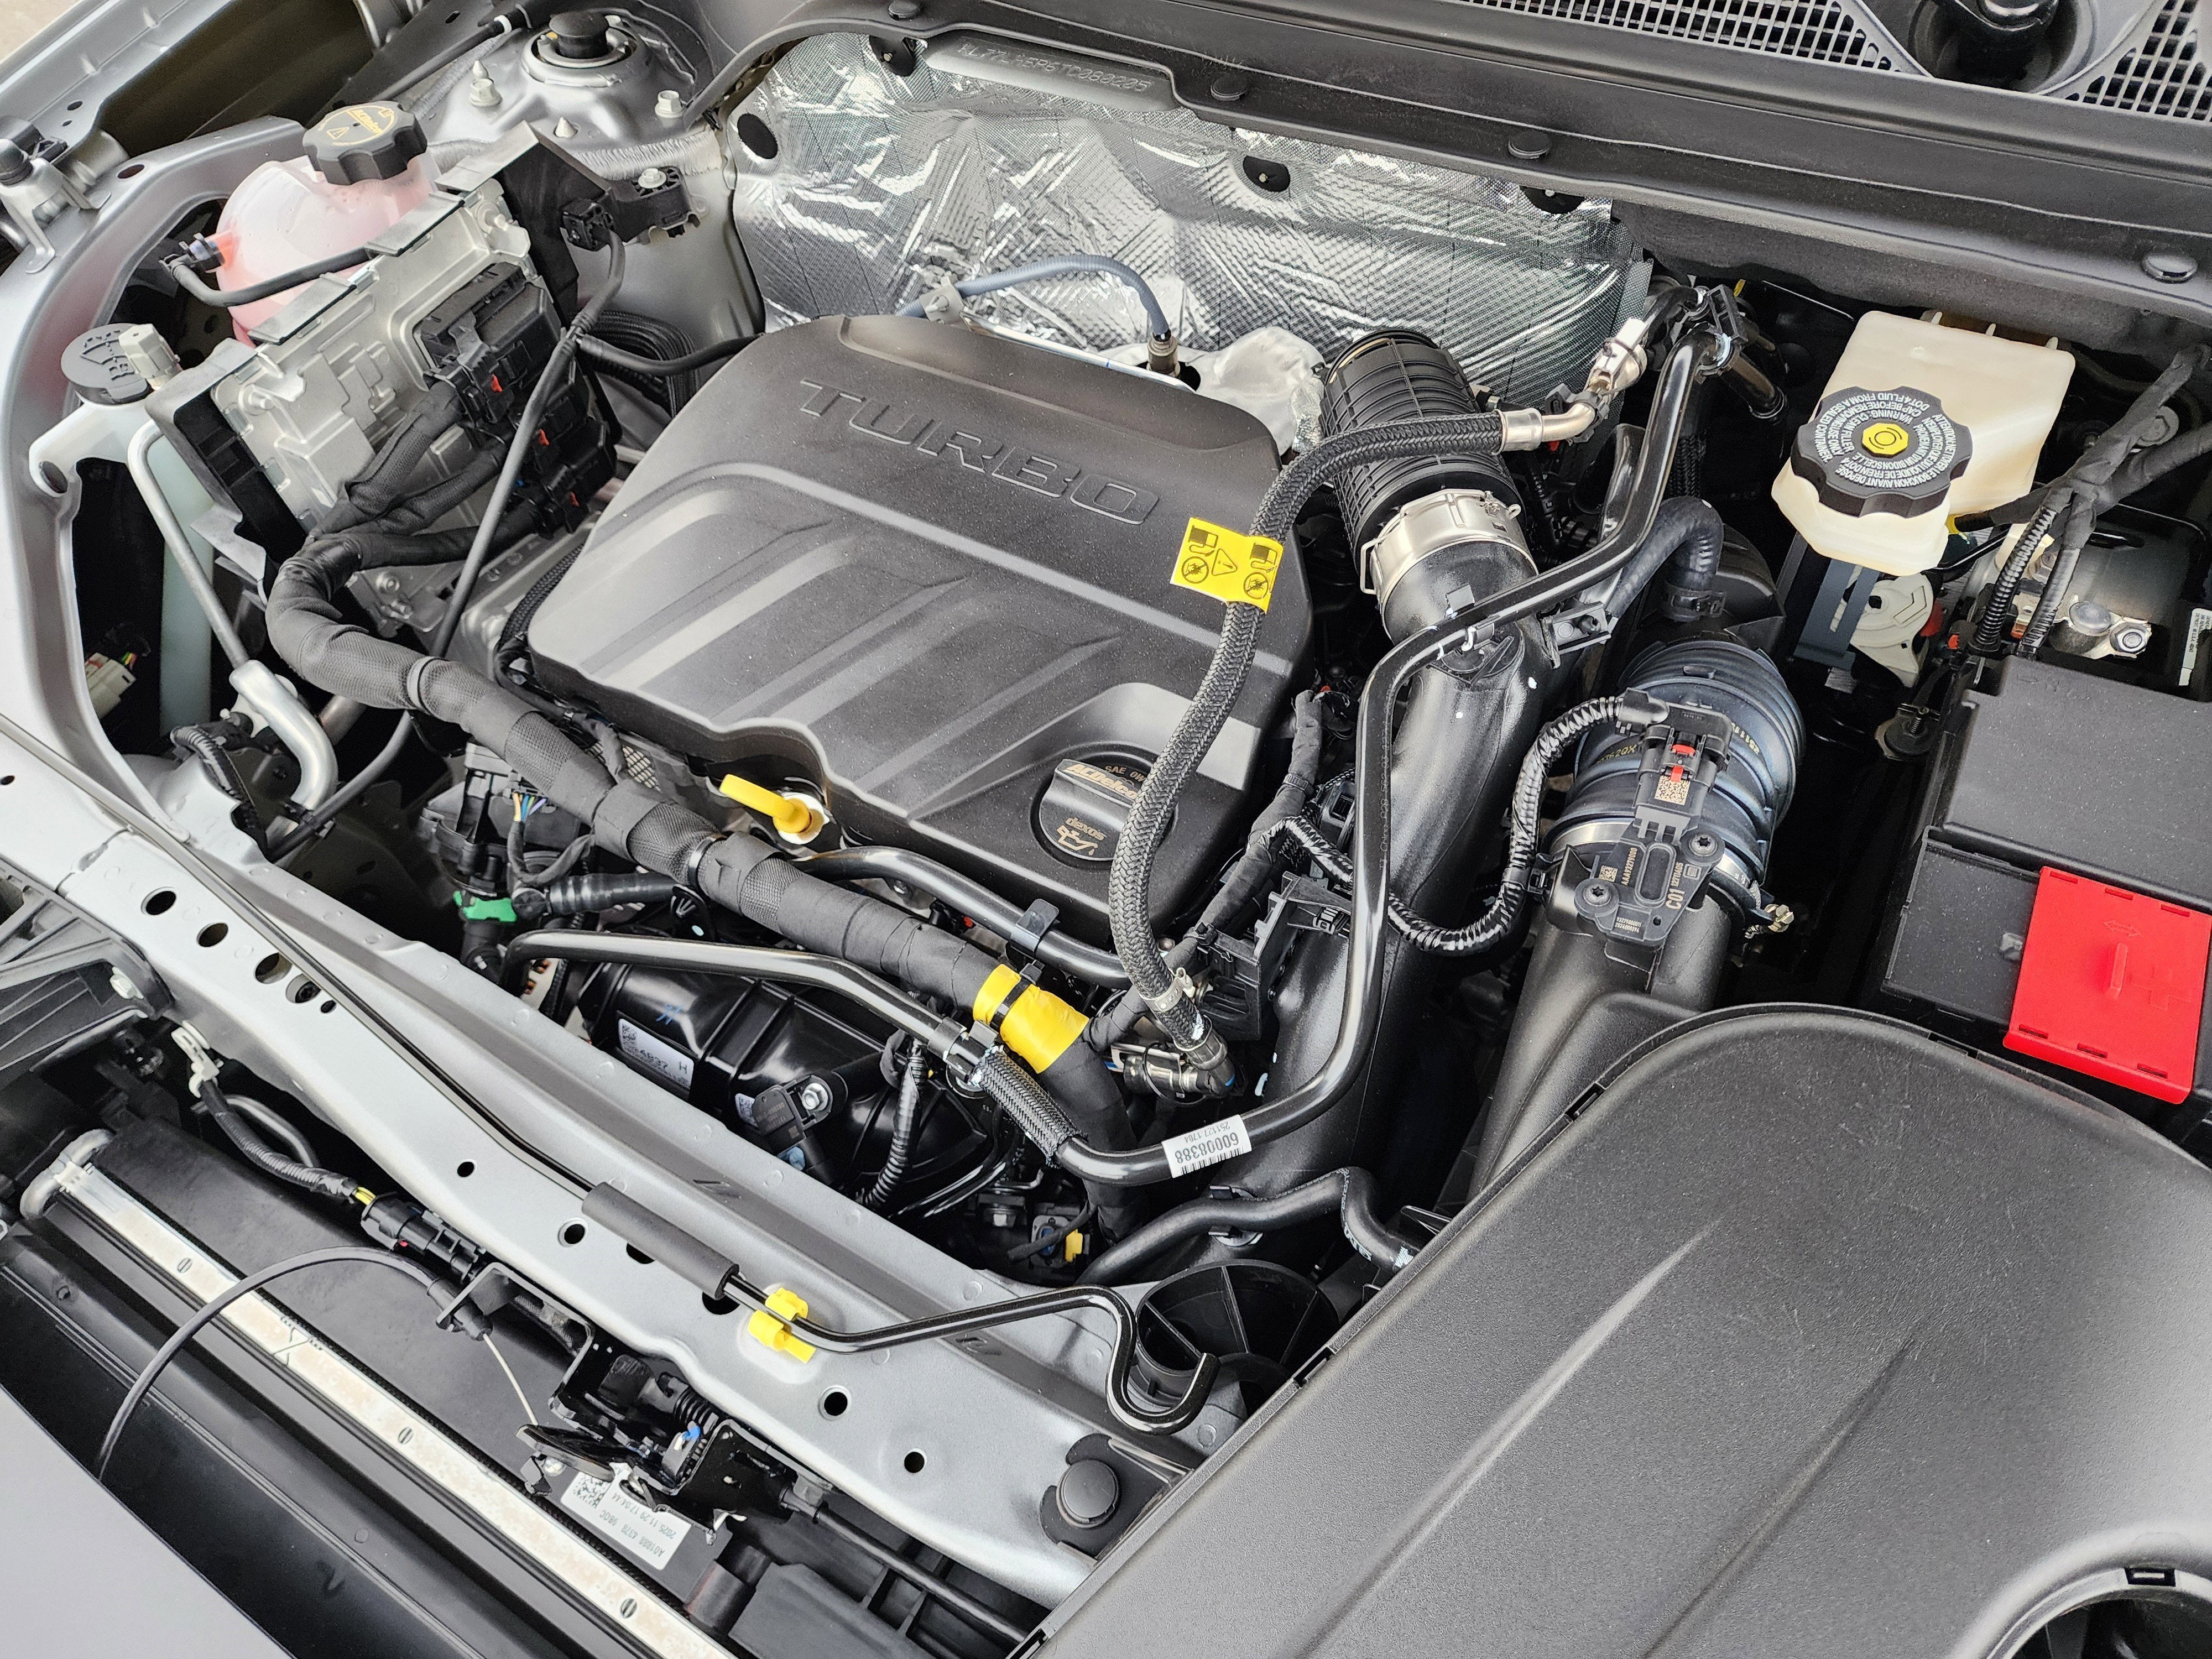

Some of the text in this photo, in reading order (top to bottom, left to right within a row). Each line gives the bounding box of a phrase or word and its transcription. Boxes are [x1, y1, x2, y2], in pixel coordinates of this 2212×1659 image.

[1848, 393, 1876, 404] FROM
[1865, 401, 1903, 410] BEFORE
[1876, 393, 1905, 402] FLUID
[1818, 401, 1846, 425] SEALED
[1901, 404, 1923, 418] CAP
[1843, 411, 1870, 431] CLEAN
[1828, 439, 1844, 457] ONLY
[1840, 429, 1855, 452] FILLER
[800, 378, 1160, 525] TURBO
[1859, 466, 1884, 478] FREIN
[1882, 460, 1907, 469] BIDON
[1864, 477, 1894, 487] AVANT
[1893, 472, 1932, 487] BOUCHON
[1104, 765, 1127, 775] SAE
[1064, 764, 1138, 800] ACDelco
[1065, 817, 1105, 841] dexos
[1666, 889, 1686, 910] C01
[1174, 1132, 1239, 1164] 60008388
